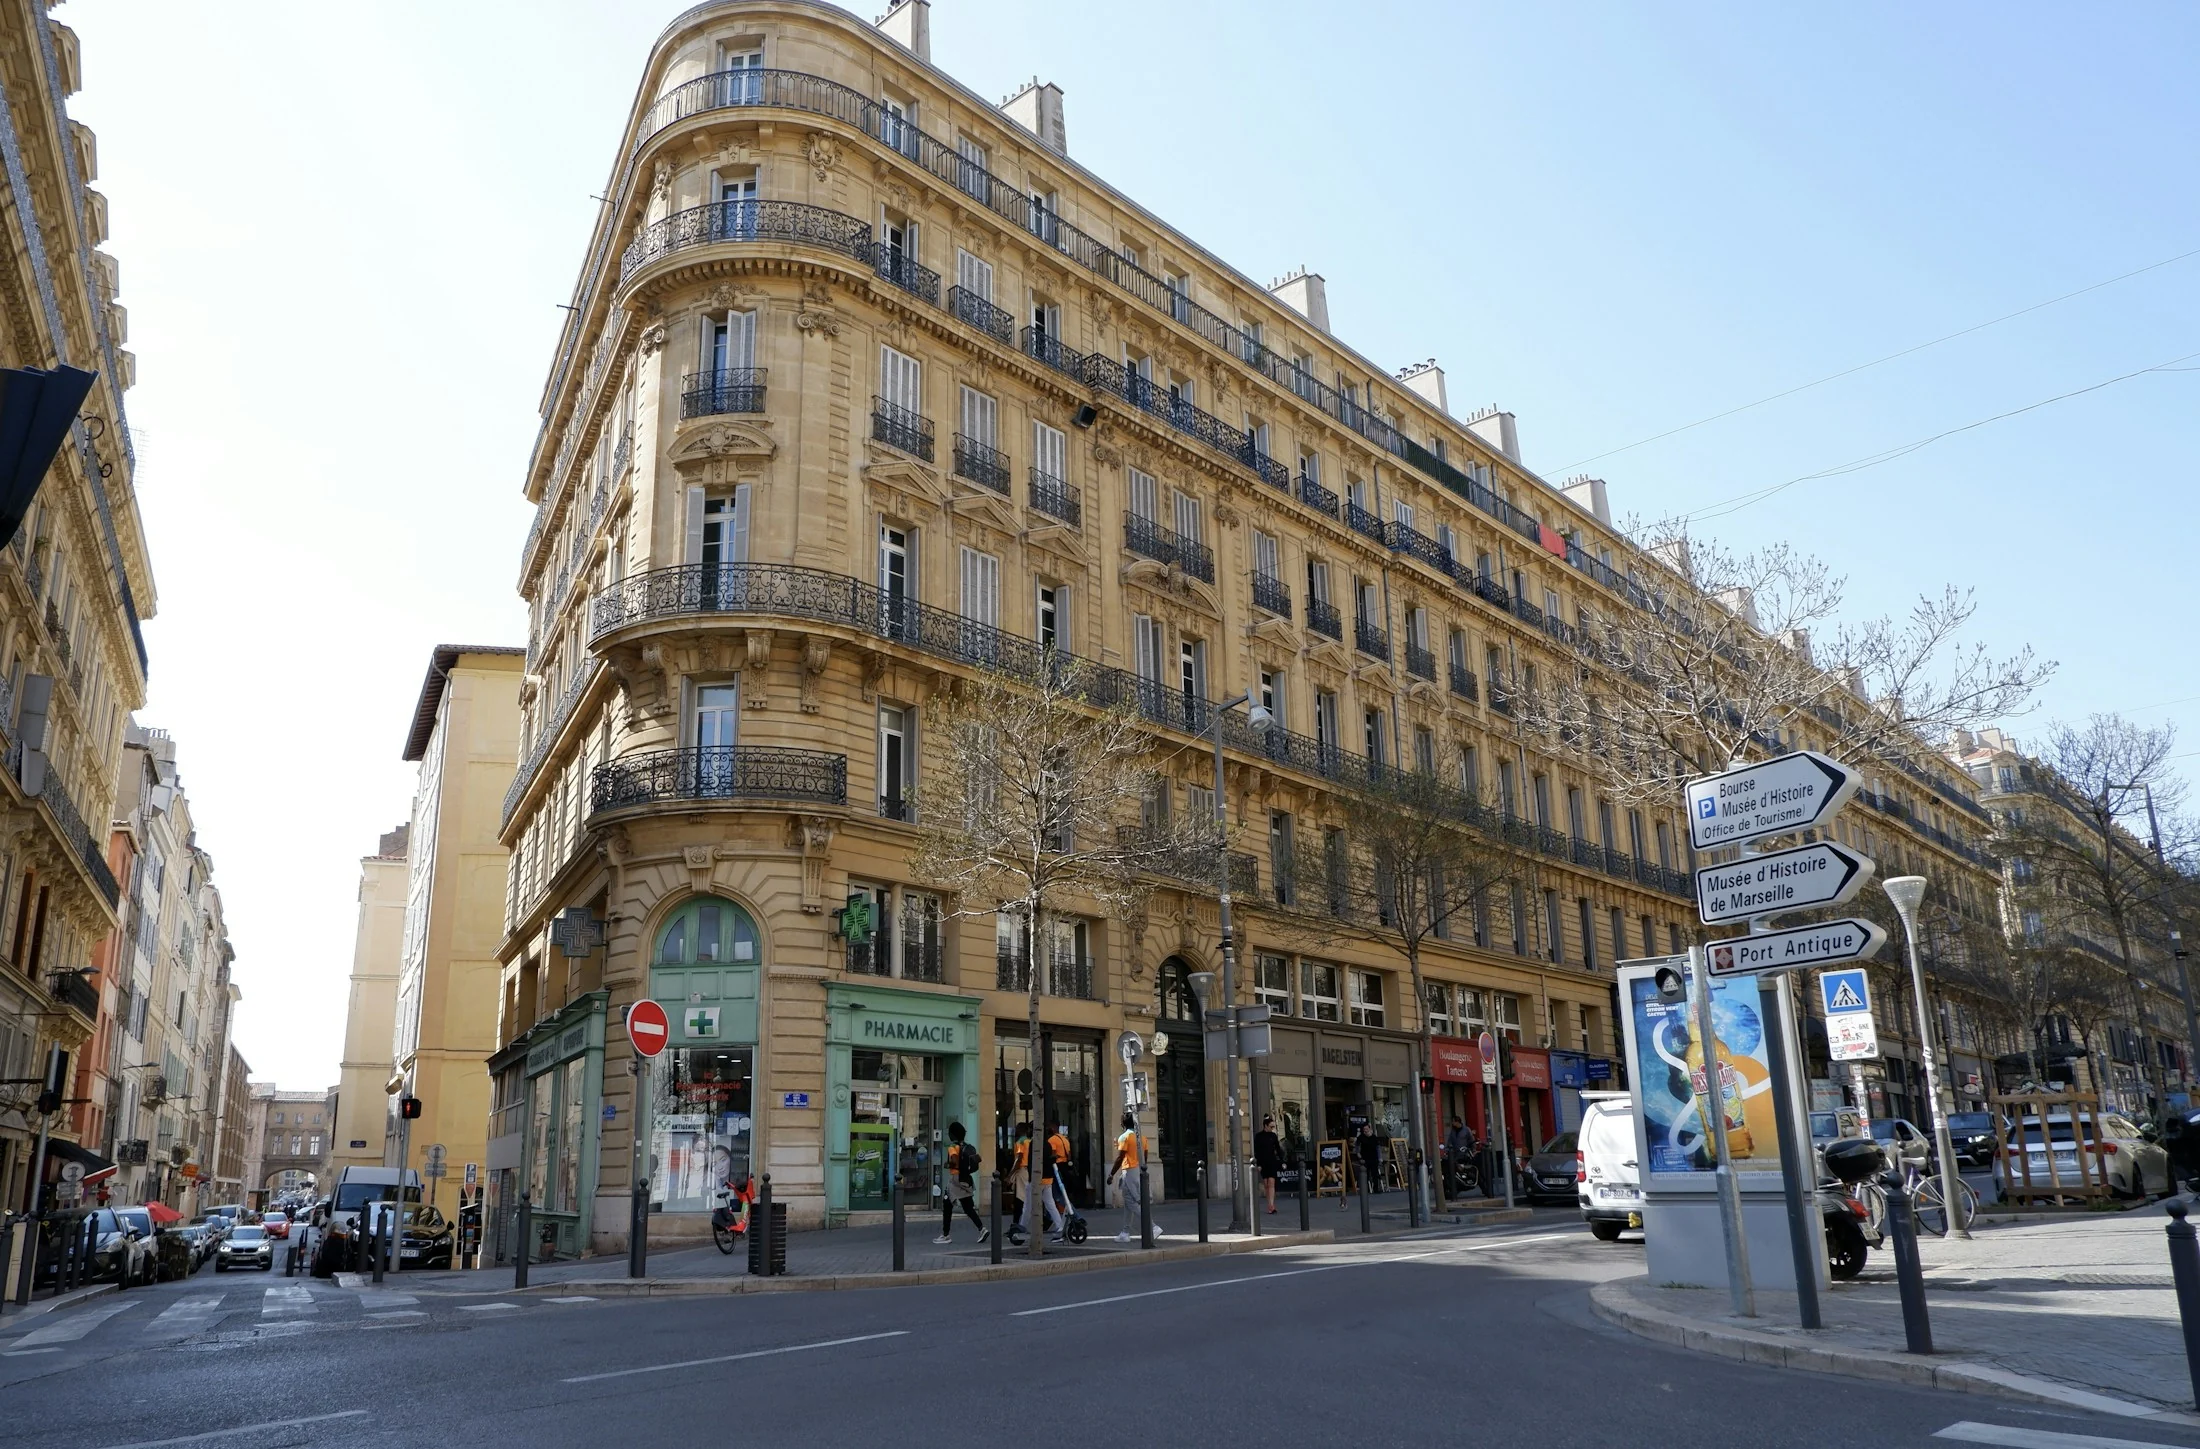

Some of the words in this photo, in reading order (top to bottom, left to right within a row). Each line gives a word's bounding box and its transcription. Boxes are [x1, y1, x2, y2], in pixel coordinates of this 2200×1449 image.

[1720, 779, 1755, 798] Bourse
[1700, 800, 1713, 818] P
[1722, 797, 1757, 818] Musée
[1760, 783, 1814, 808] d'Histoire
[1702, 823, 1735, 839] (Office
[1738, 818, 1751, 831] de
[1754, 803, 1806, 827] Tourisme)
[1707, 870, 1752, 893] Musée
[1757, 856, 1827, 882] d'Histoire
[1710, 897, 1726, 913] de
[1730, 884, 1794, 909] Marseille
[1740, 945, 1773, 963] Port
[1785, 934, 1853, 957] Antique
[864, 1020, 954, 1043] PHARMACIE
[1321, 1047, 1362, 1066] BAGELSTEIN
[1438, 1048, 1472, 1064] Boulangerie
[1276, 1168, 1313, 1178] BAGELSIN
